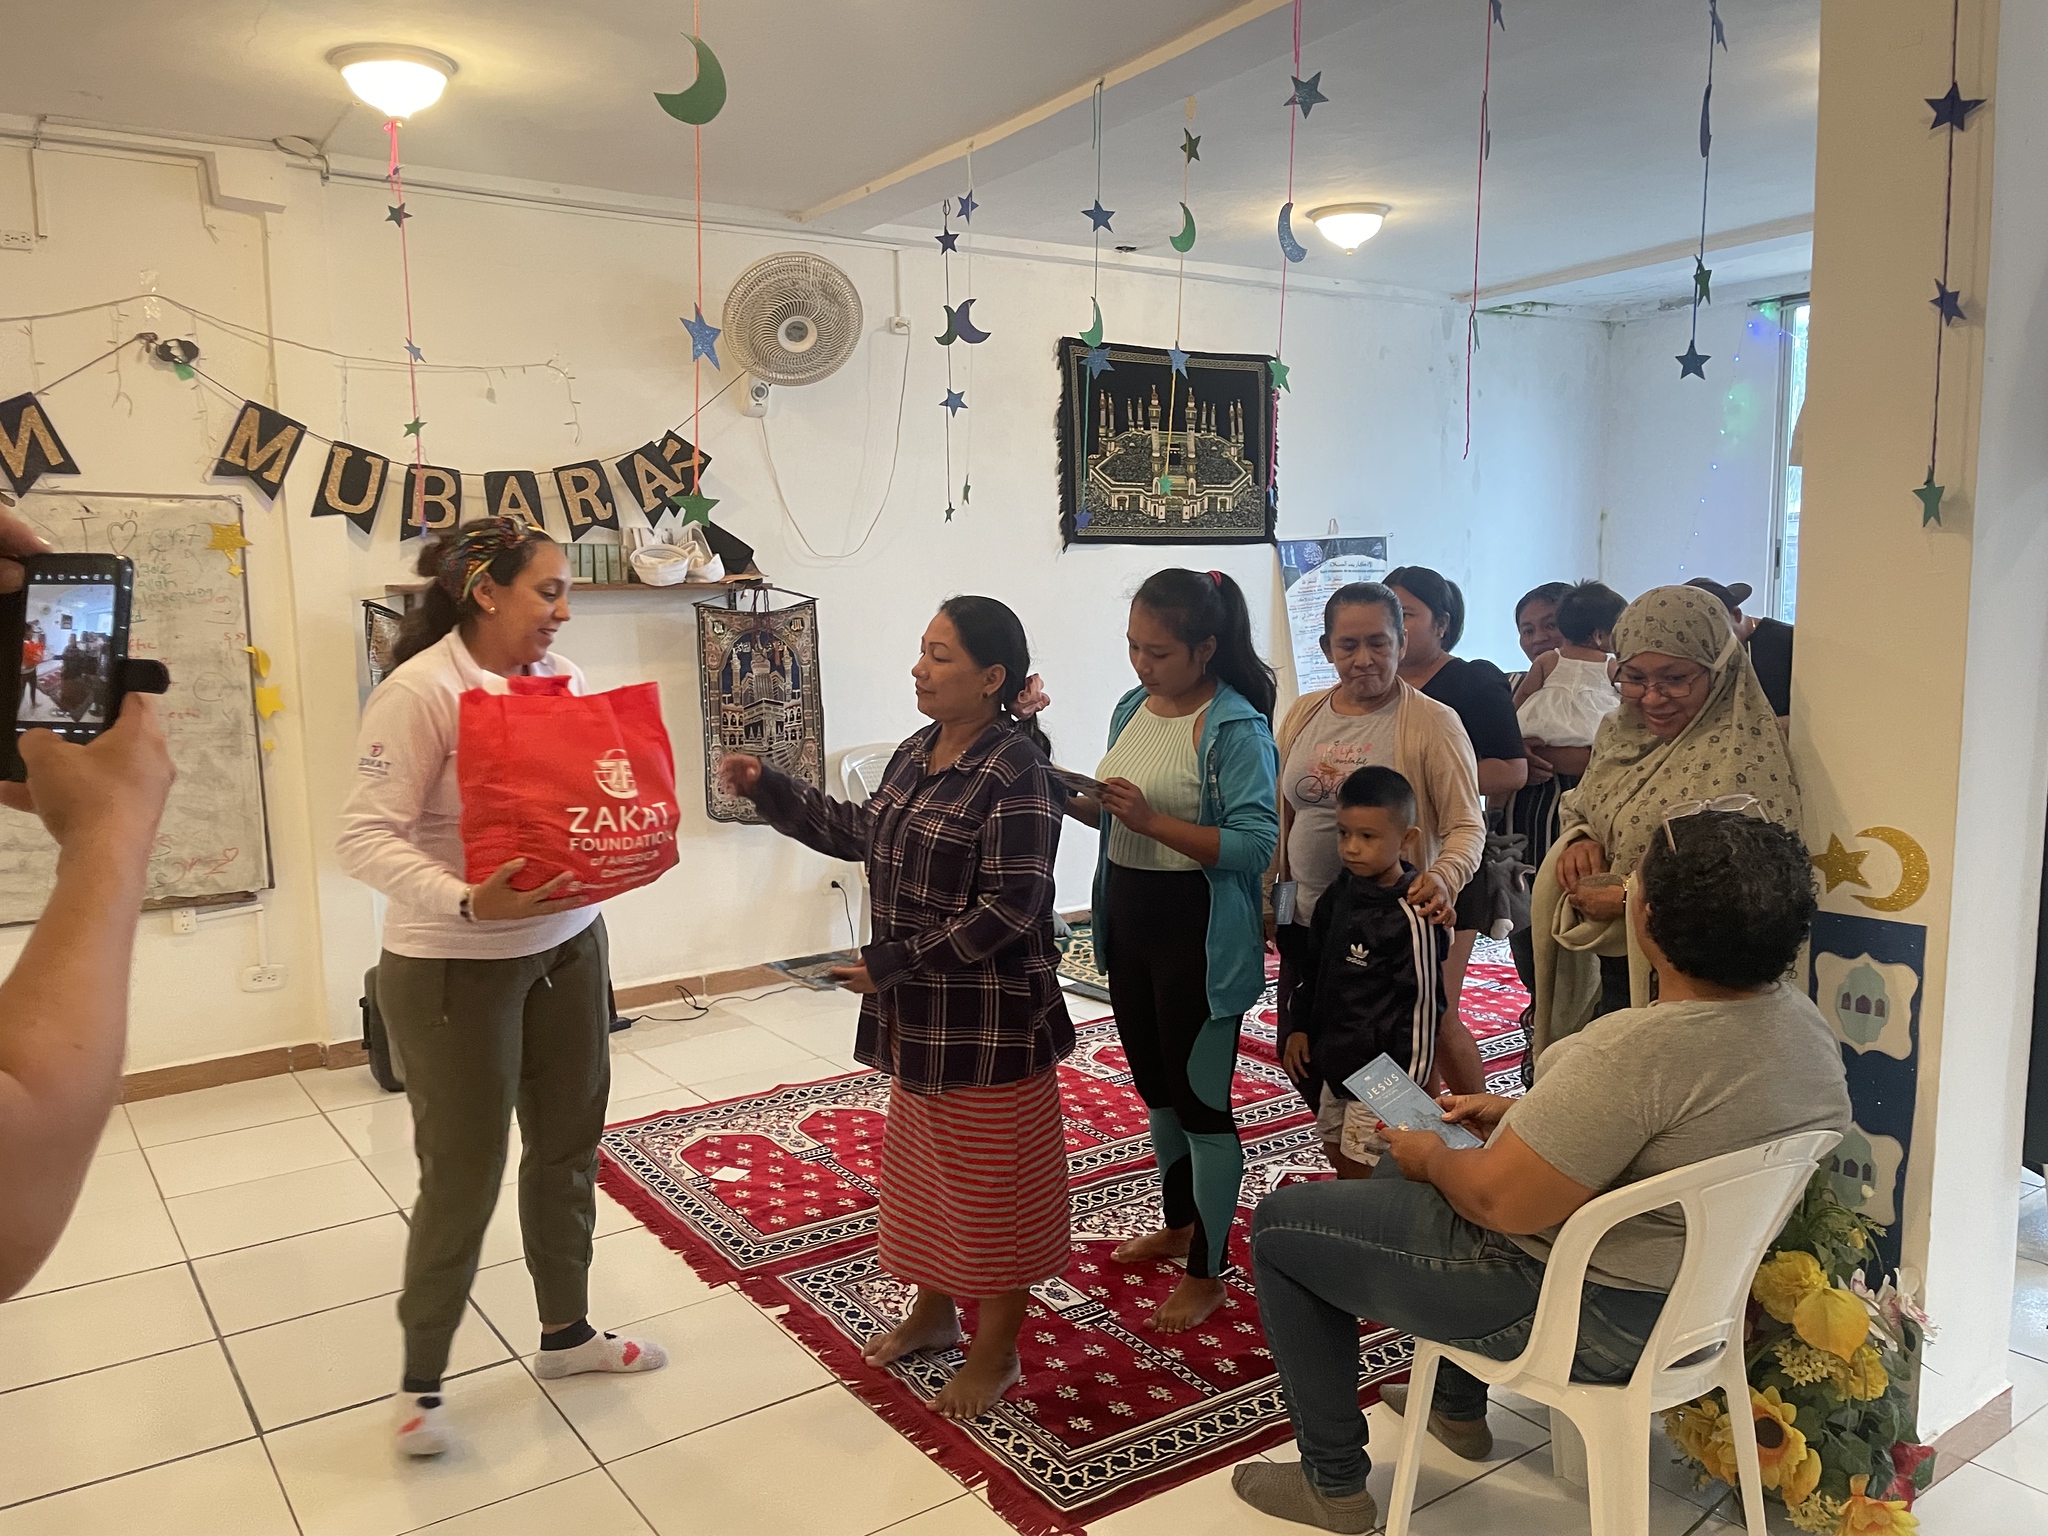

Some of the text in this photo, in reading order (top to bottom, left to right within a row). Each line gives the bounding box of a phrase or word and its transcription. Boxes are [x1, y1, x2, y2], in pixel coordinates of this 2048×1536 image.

[566, 802, 669, 833] ZAKAT
[569, 831, 674, 851] FOUNDATION
[1366, 1073, 1399, 1099] JESÚS
